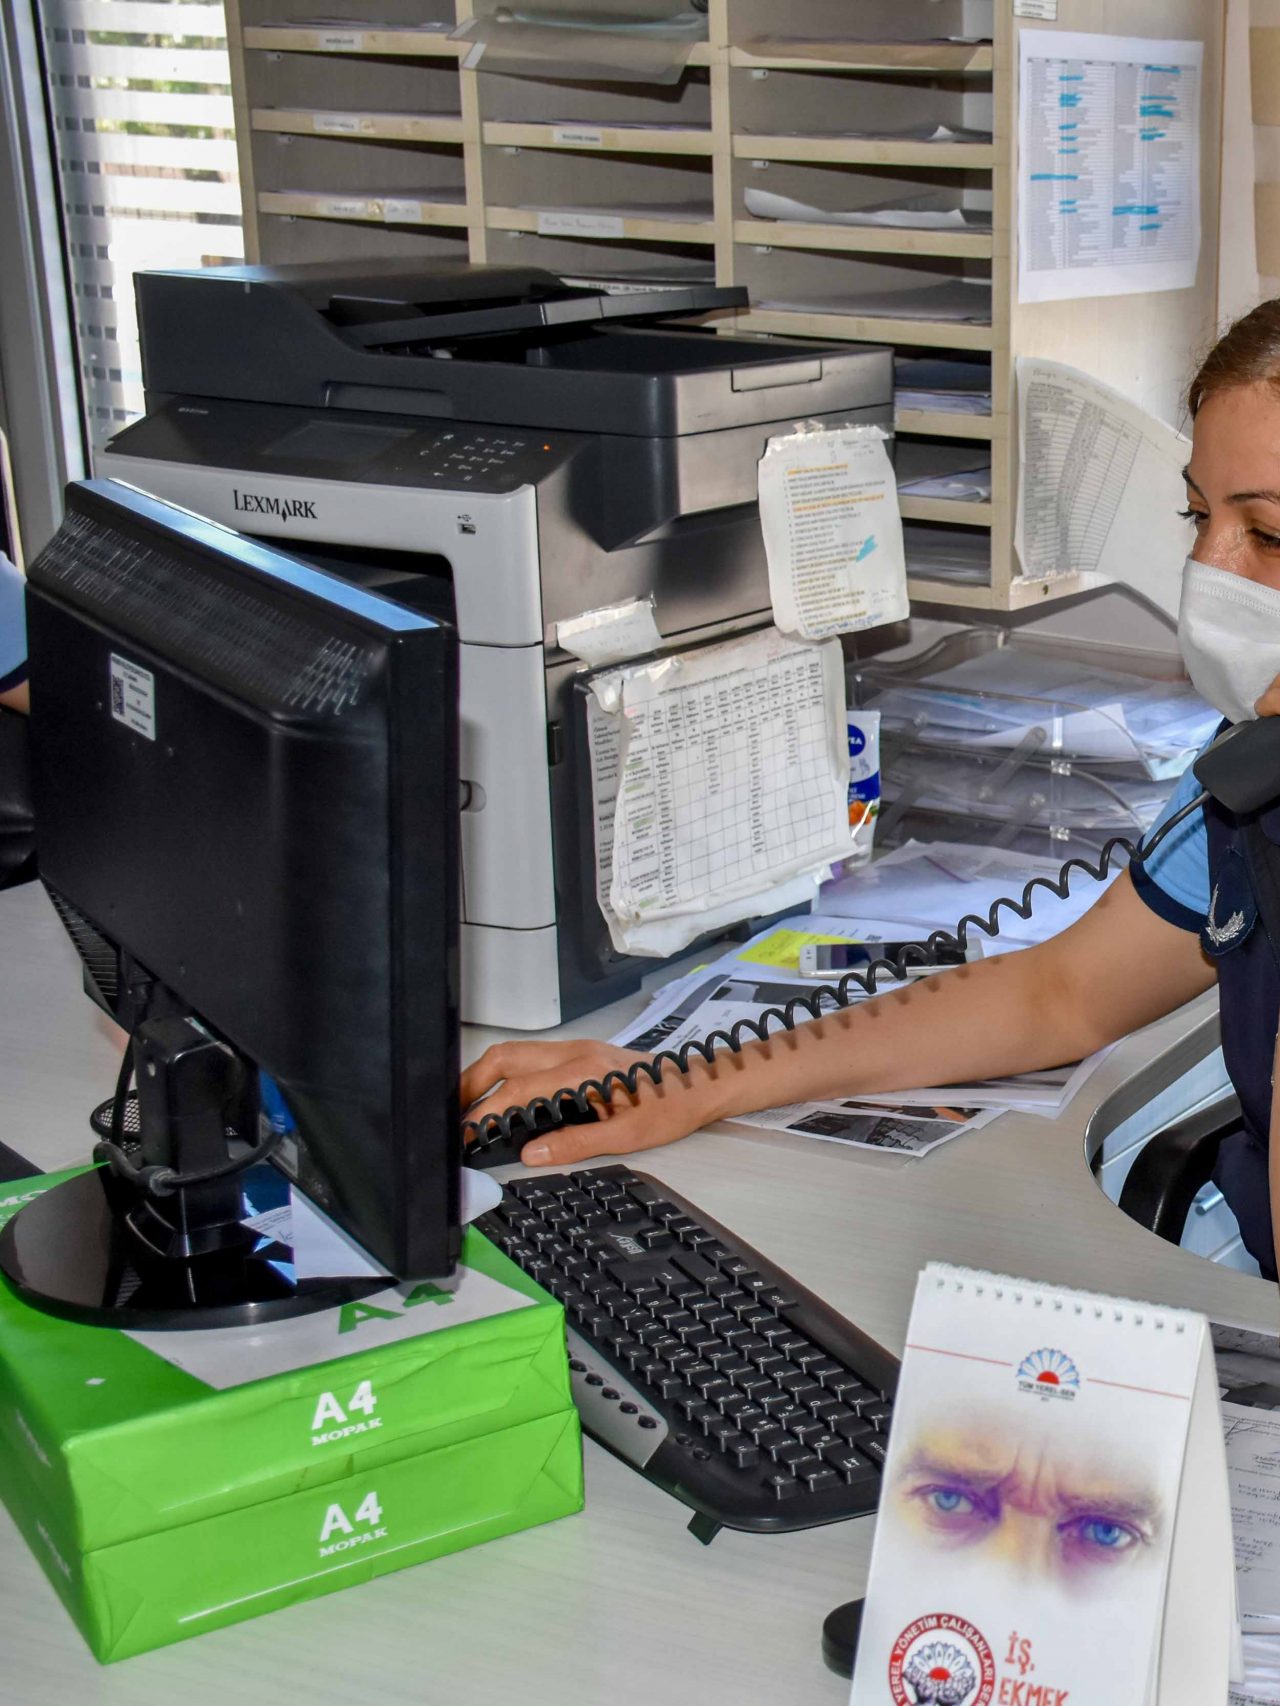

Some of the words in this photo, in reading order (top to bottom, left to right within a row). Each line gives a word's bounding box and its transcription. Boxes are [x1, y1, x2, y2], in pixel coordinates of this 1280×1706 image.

[233, 489, 317, 522] LEXMARK
[338, 1282, 457, 1335] A4
[312, 1380, 377, 1430] A4
[312, 1418, 383, 1446] MOPAK
[320, 1491, 383, 1542] A4
[320, 1527, 388, 1557] MOPAK
[894, 1616, 938, 1659] YÖNETİM
[940, 1615, 993, 1681] ÇALIŞANLARI
